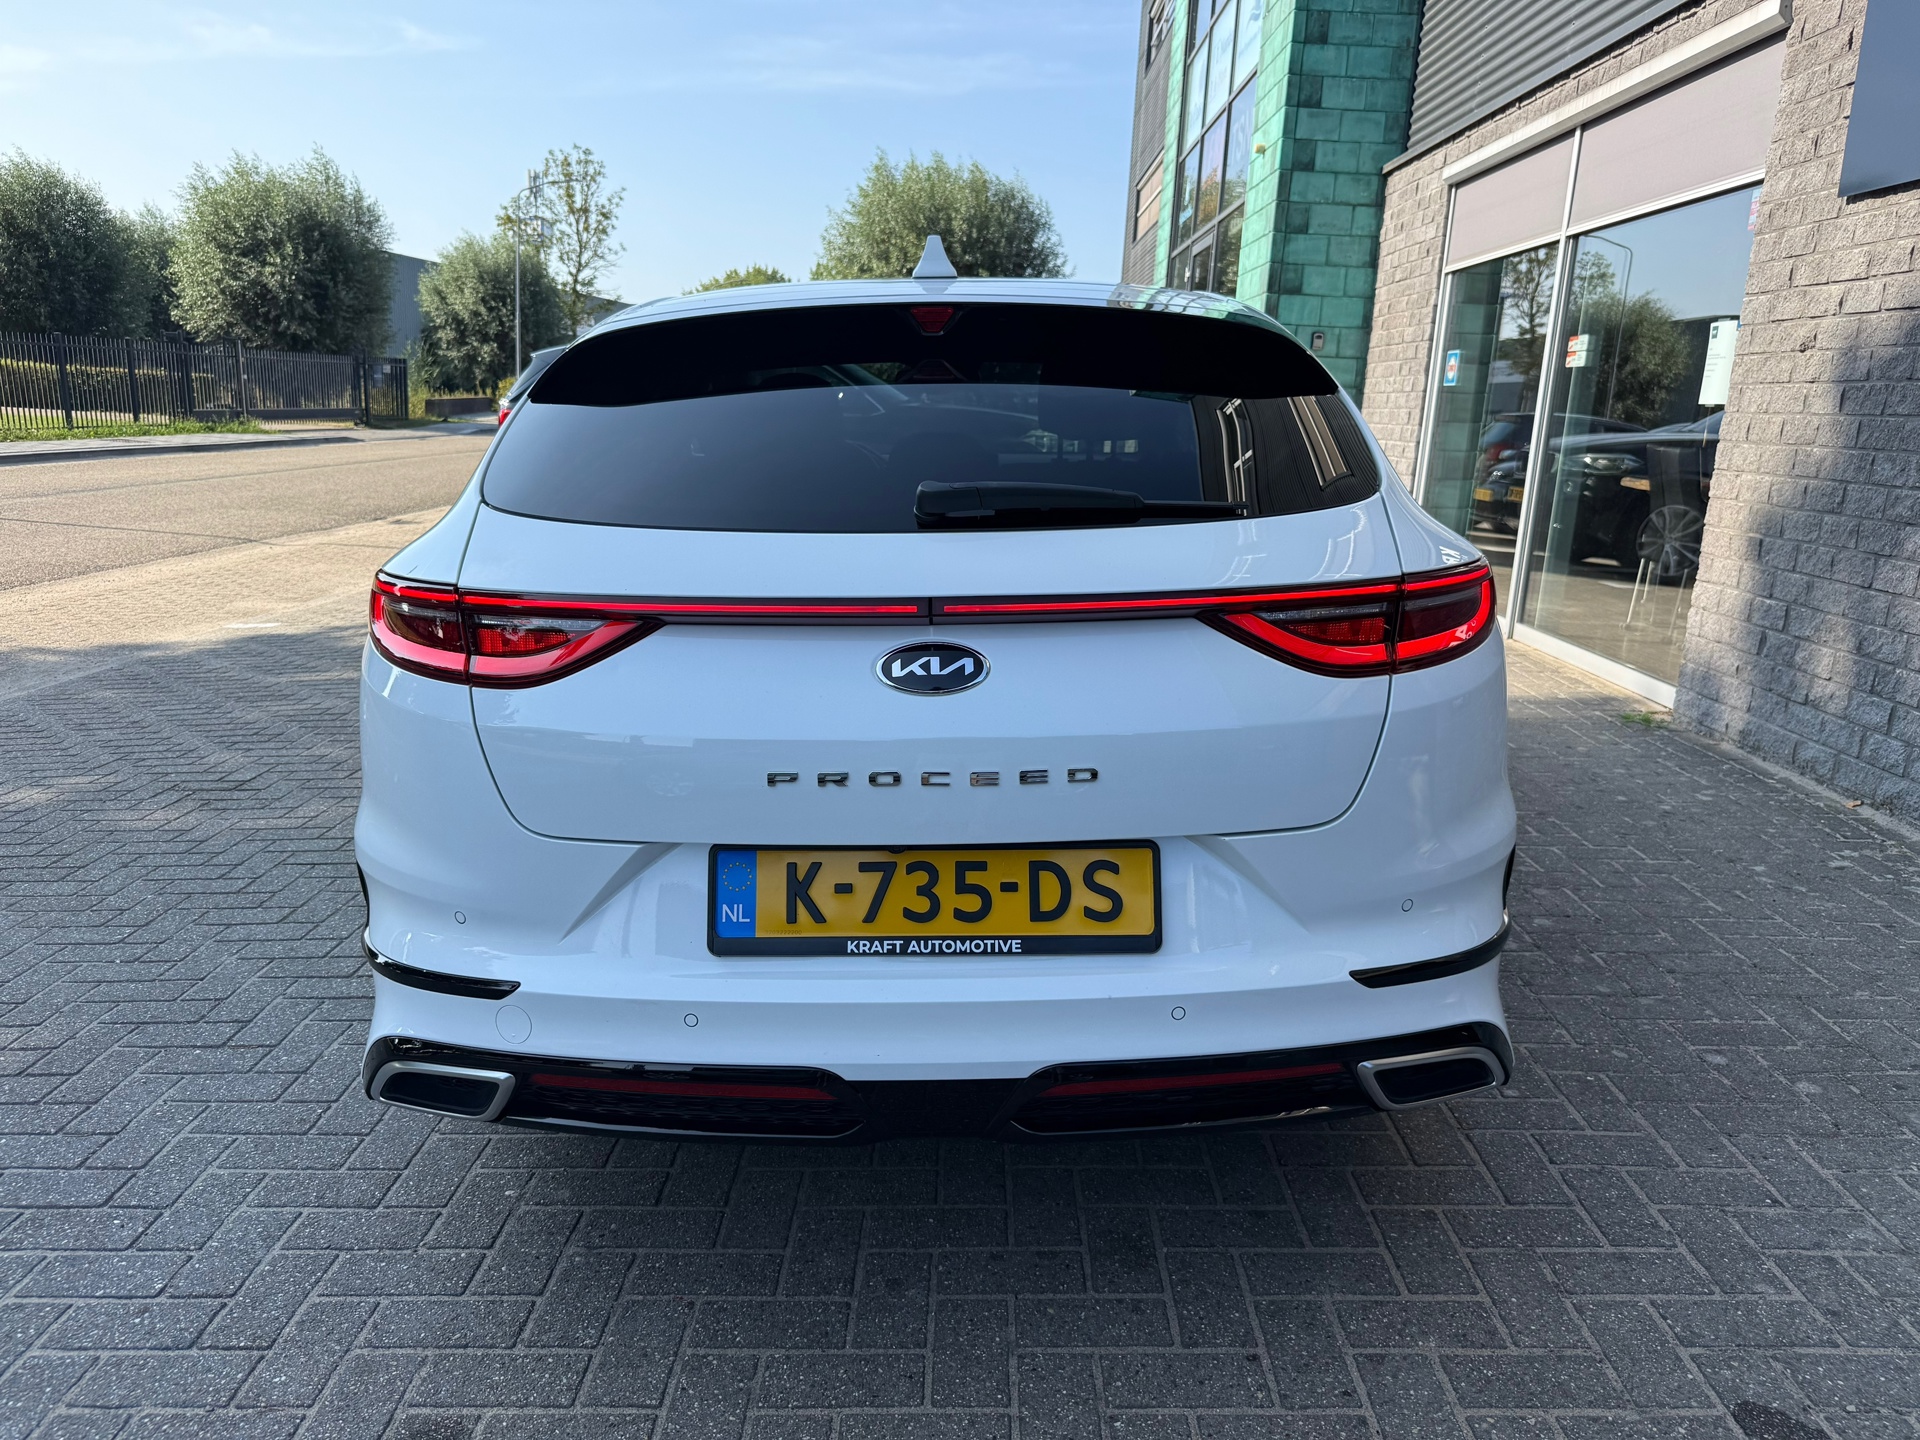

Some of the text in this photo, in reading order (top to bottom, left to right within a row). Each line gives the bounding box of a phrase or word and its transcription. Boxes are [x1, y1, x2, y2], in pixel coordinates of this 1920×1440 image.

[891, 656, 975, 678] KIA
[766, 767, 1100, 788] PROCEED
[785, 858, 1124, 925] K-735-DS
[721, 904, 750, 923] NL
[846, 940, 1022, 954] KRAFT AUTOMOTIVE
